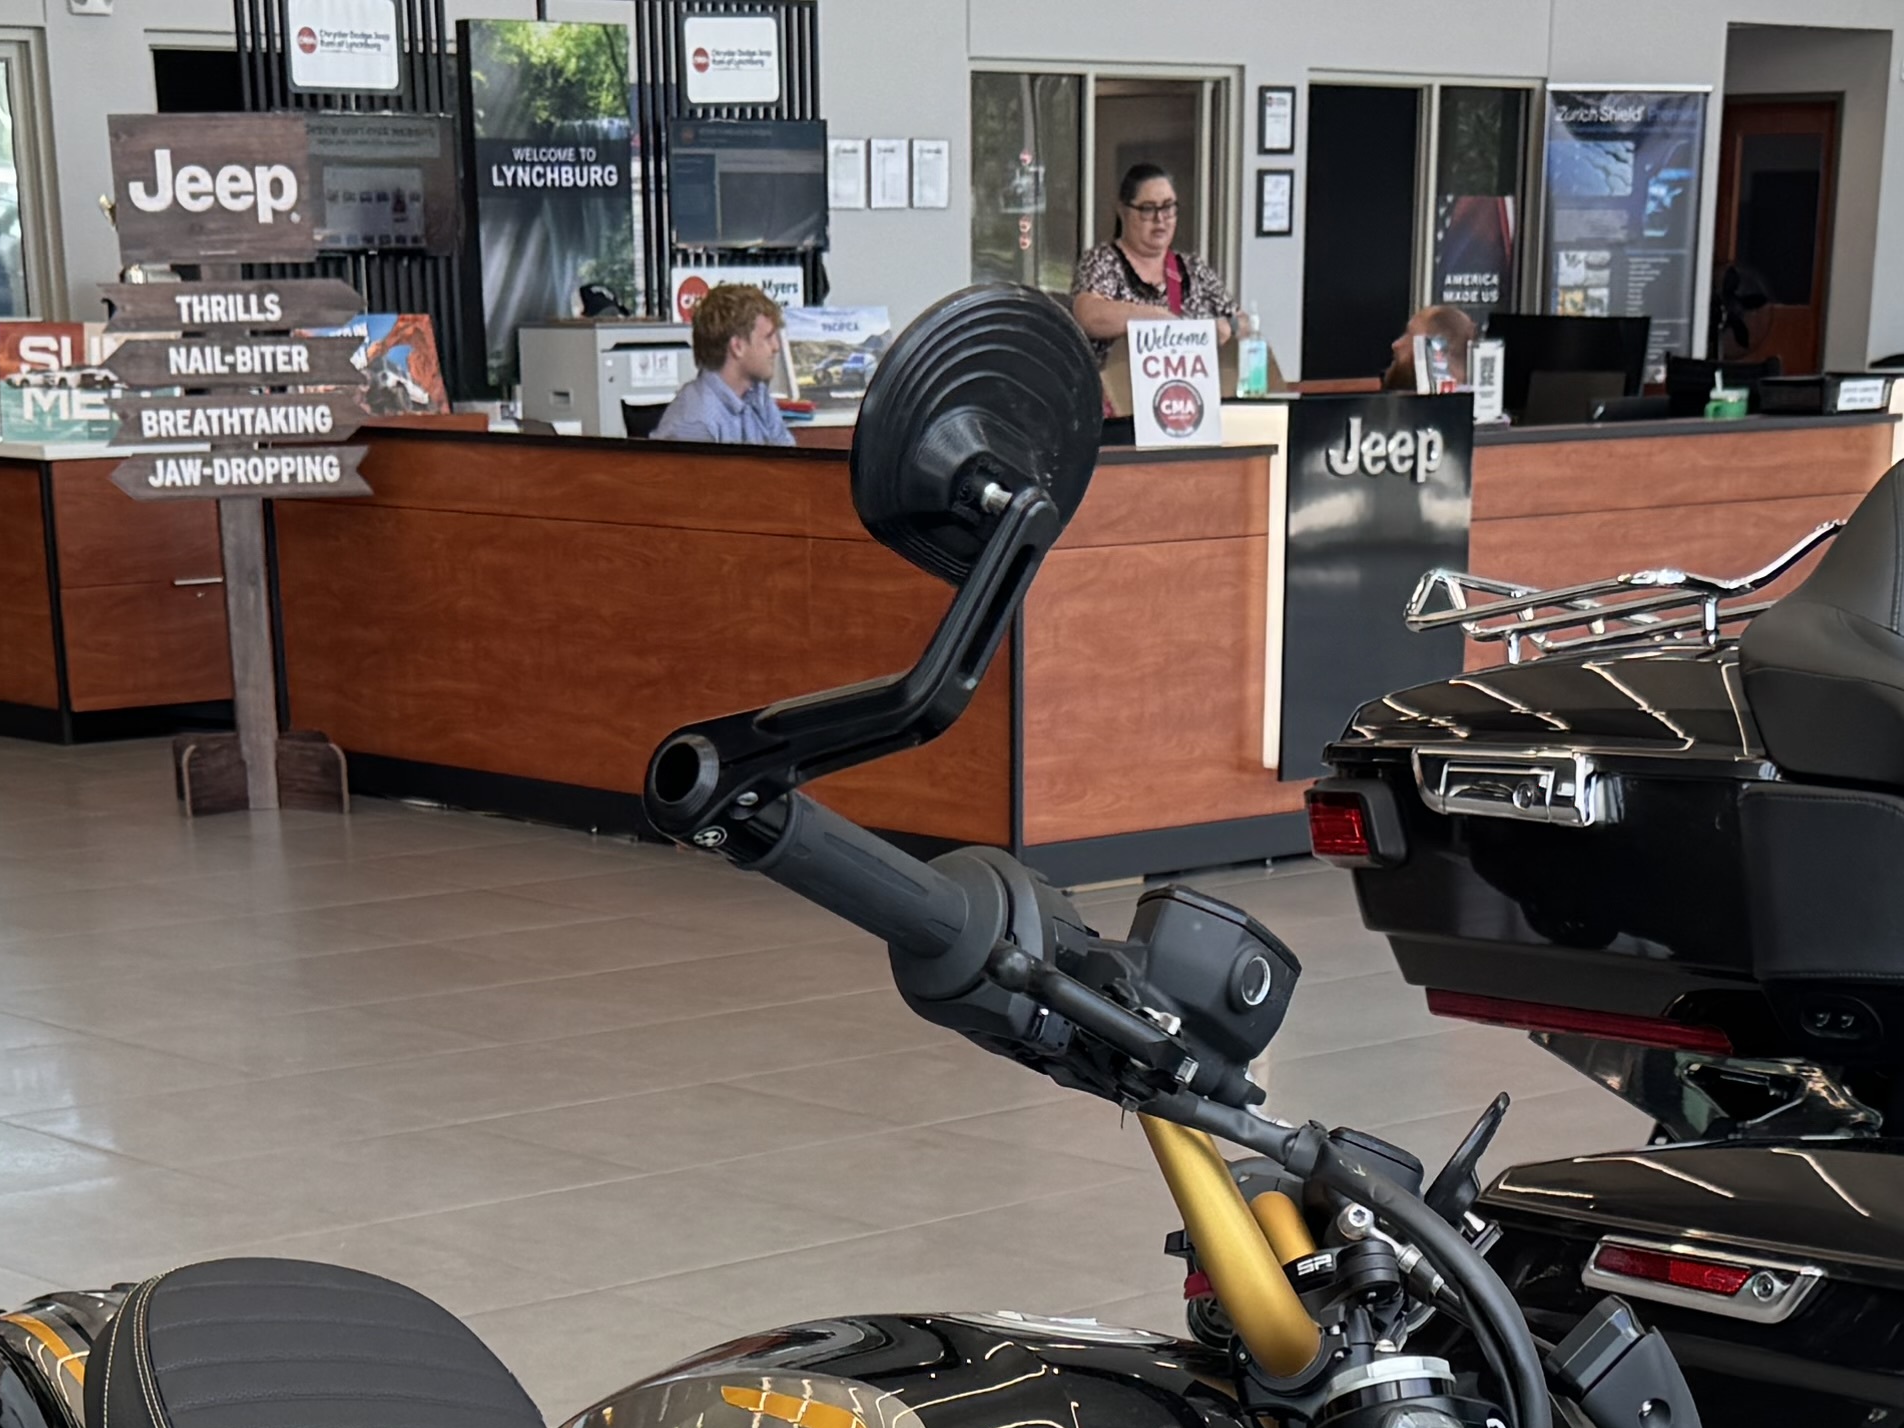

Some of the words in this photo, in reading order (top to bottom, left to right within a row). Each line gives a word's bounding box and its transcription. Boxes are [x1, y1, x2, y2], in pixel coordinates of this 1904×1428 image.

[1554, 105, 1598, 122] Zurich
[512, 147, 576, 161] WELCOME
[579, 147, 596, 161] TO
[128, 148, 299, 224] Jeep
[491, 164, 618, 187] LYNCHBURG
[1444, 273, 1499, 286] AMERICA
[175, 293, 282, 324] THRILLS
[1442, 290, 1478, 303] MADE
[18, 335, 116, 373] SU
[1136, 324, 1209, 355] Welcome
[169, 344, 309, 375] NAIL-BITER
[1142, 355, 1209, 379] CMA
[22, 388, 122, 421] ME
[1159, 399, 1196, 415] CMA
[141, 405, 333, 438] BREATHTAKING
[1326, 416, 1444, 482] Jeep
[147, 454, 341, 488] JAW-DROPPING
